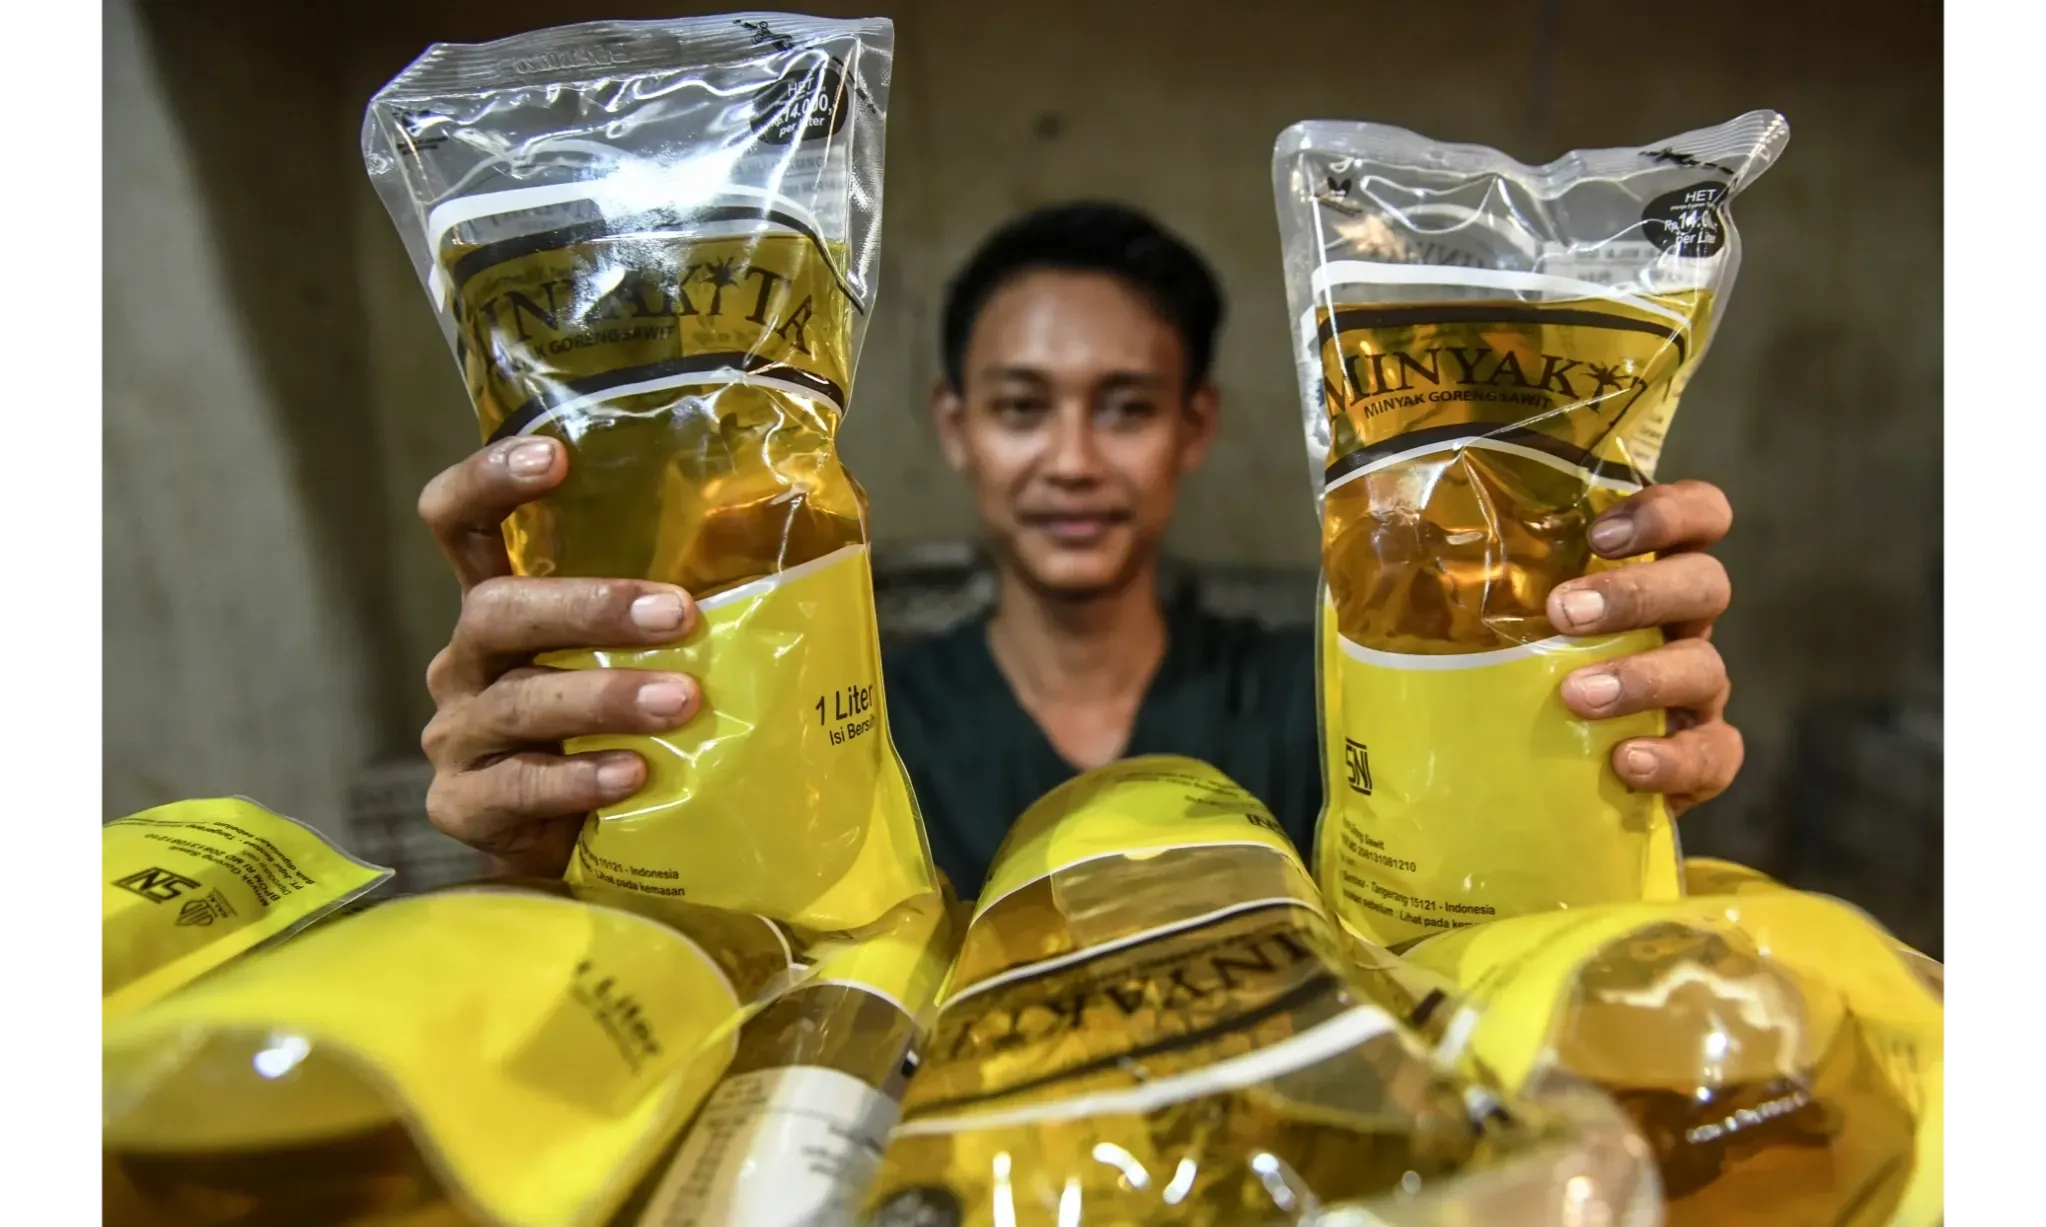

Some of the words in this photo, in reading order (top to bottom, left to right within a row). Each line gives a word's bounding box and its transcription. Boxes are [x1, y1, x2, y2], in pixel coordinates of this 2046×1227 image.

[1684, 189, 1717, 203] HET
[1363, 393, 1424, 419] MINYAK
[1428, 390, 1497, 403] GORENG
[815, 696, 825, 726] 1
[836, 684, 873, 720] Liter
[829, 726, 845, 746] Isi
[847, 713, 876, 739] Bers
[630, 866, 679, 880] Indonesia
[254, 874, 281, 902] BPOM
[639, 882, 685, 896] kemasan
[1411, 896, 1436, 911] 15121
[1445, 902, 1495, 915] Indonesia
[1400, 910, 1422, 926] Lihat
[1424, 916, 1449, 928] pada
